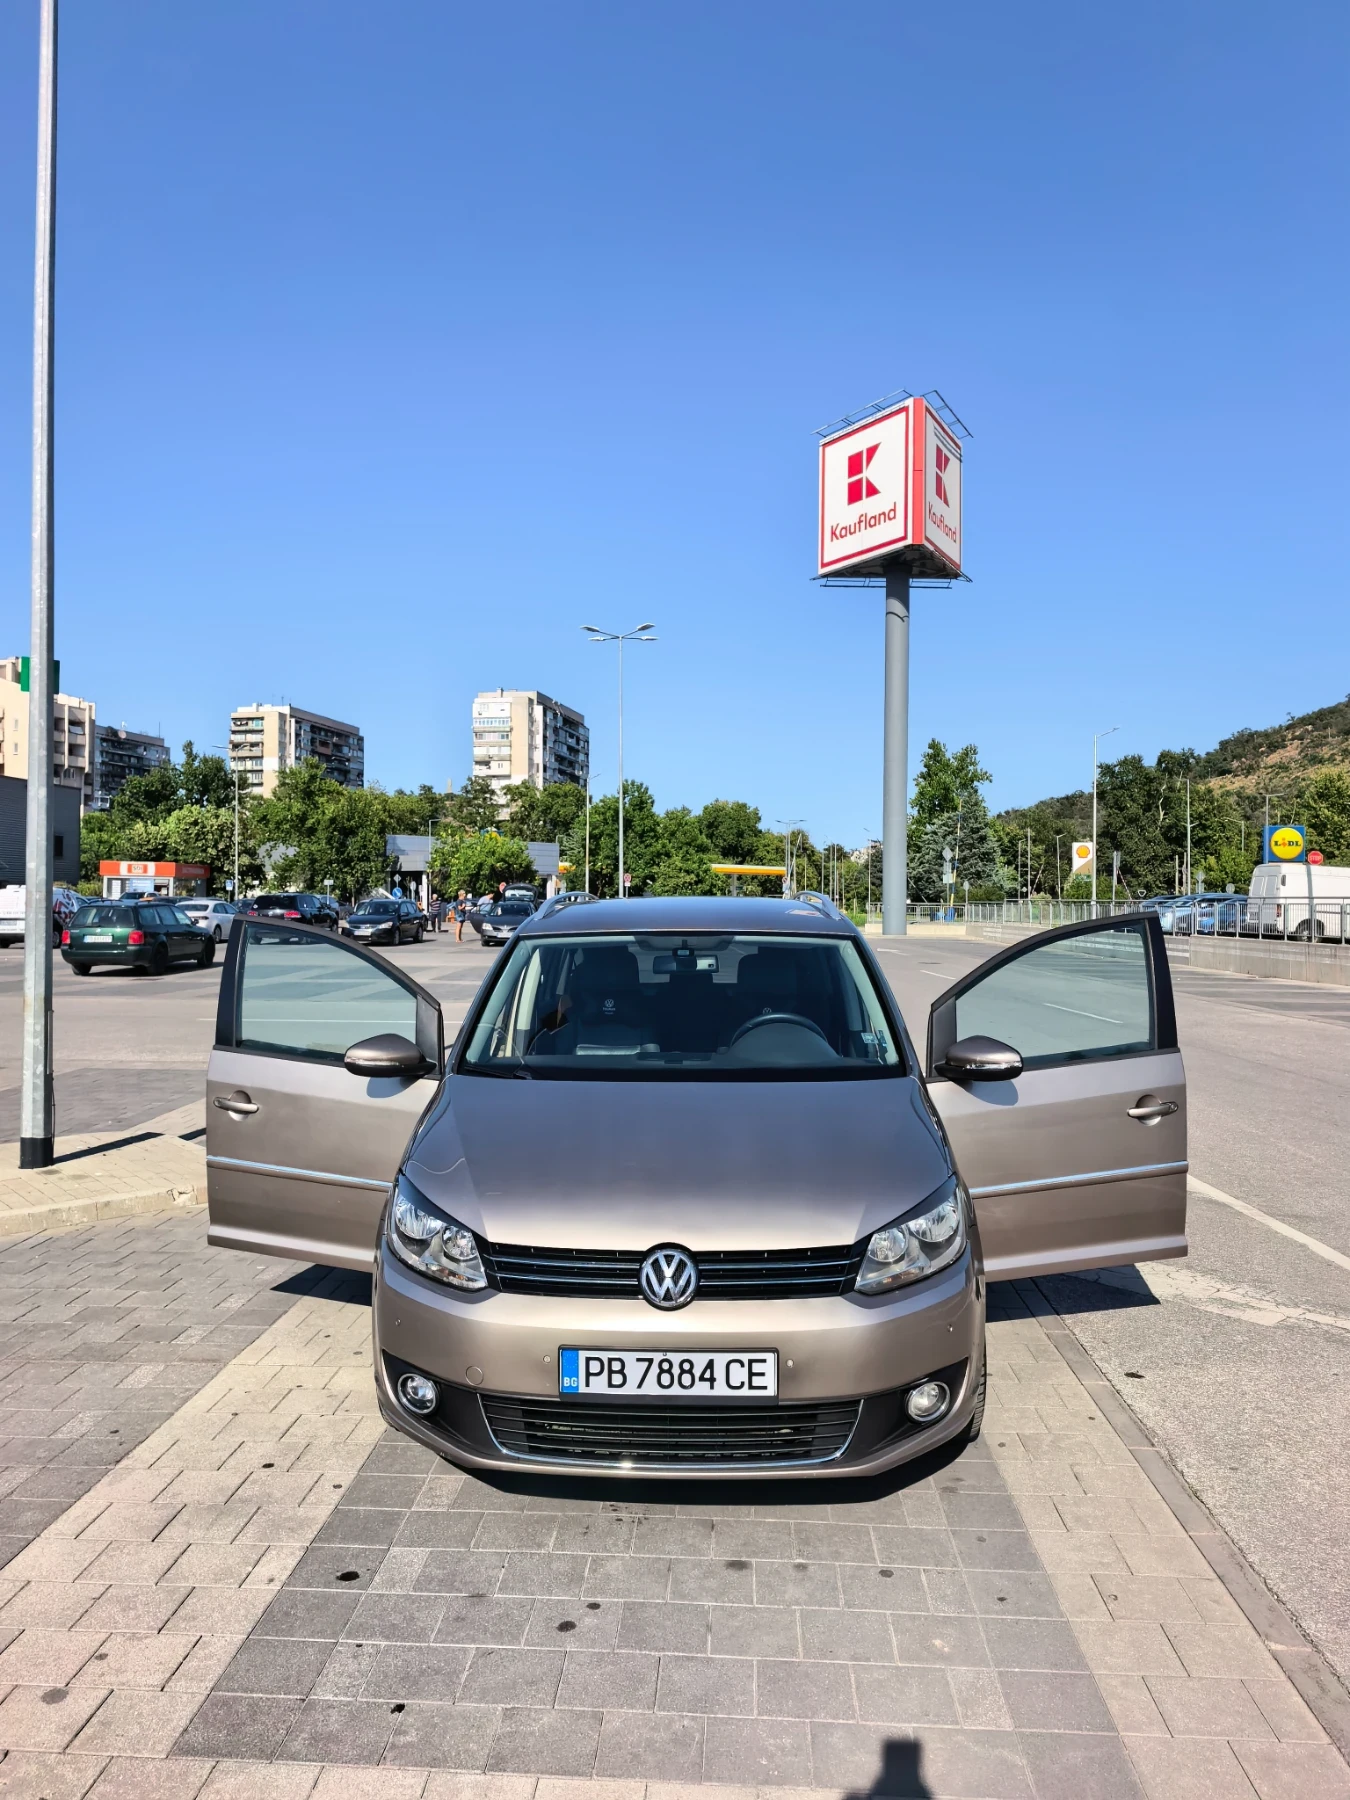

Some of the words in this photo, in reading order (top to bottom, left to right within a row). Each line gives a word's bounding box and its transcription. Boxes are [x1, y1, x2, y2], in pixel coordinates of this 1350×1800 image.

[830, 501, 897, 543] Kaufland
[928, 501, 957, 544] Kaufland
[563, 1377, 578, 1388] BG
[584, 1356, 628, 1389] PB
[635, 1358, 717, 1390] 7884
[725, 1358, 768, 1390] CE
